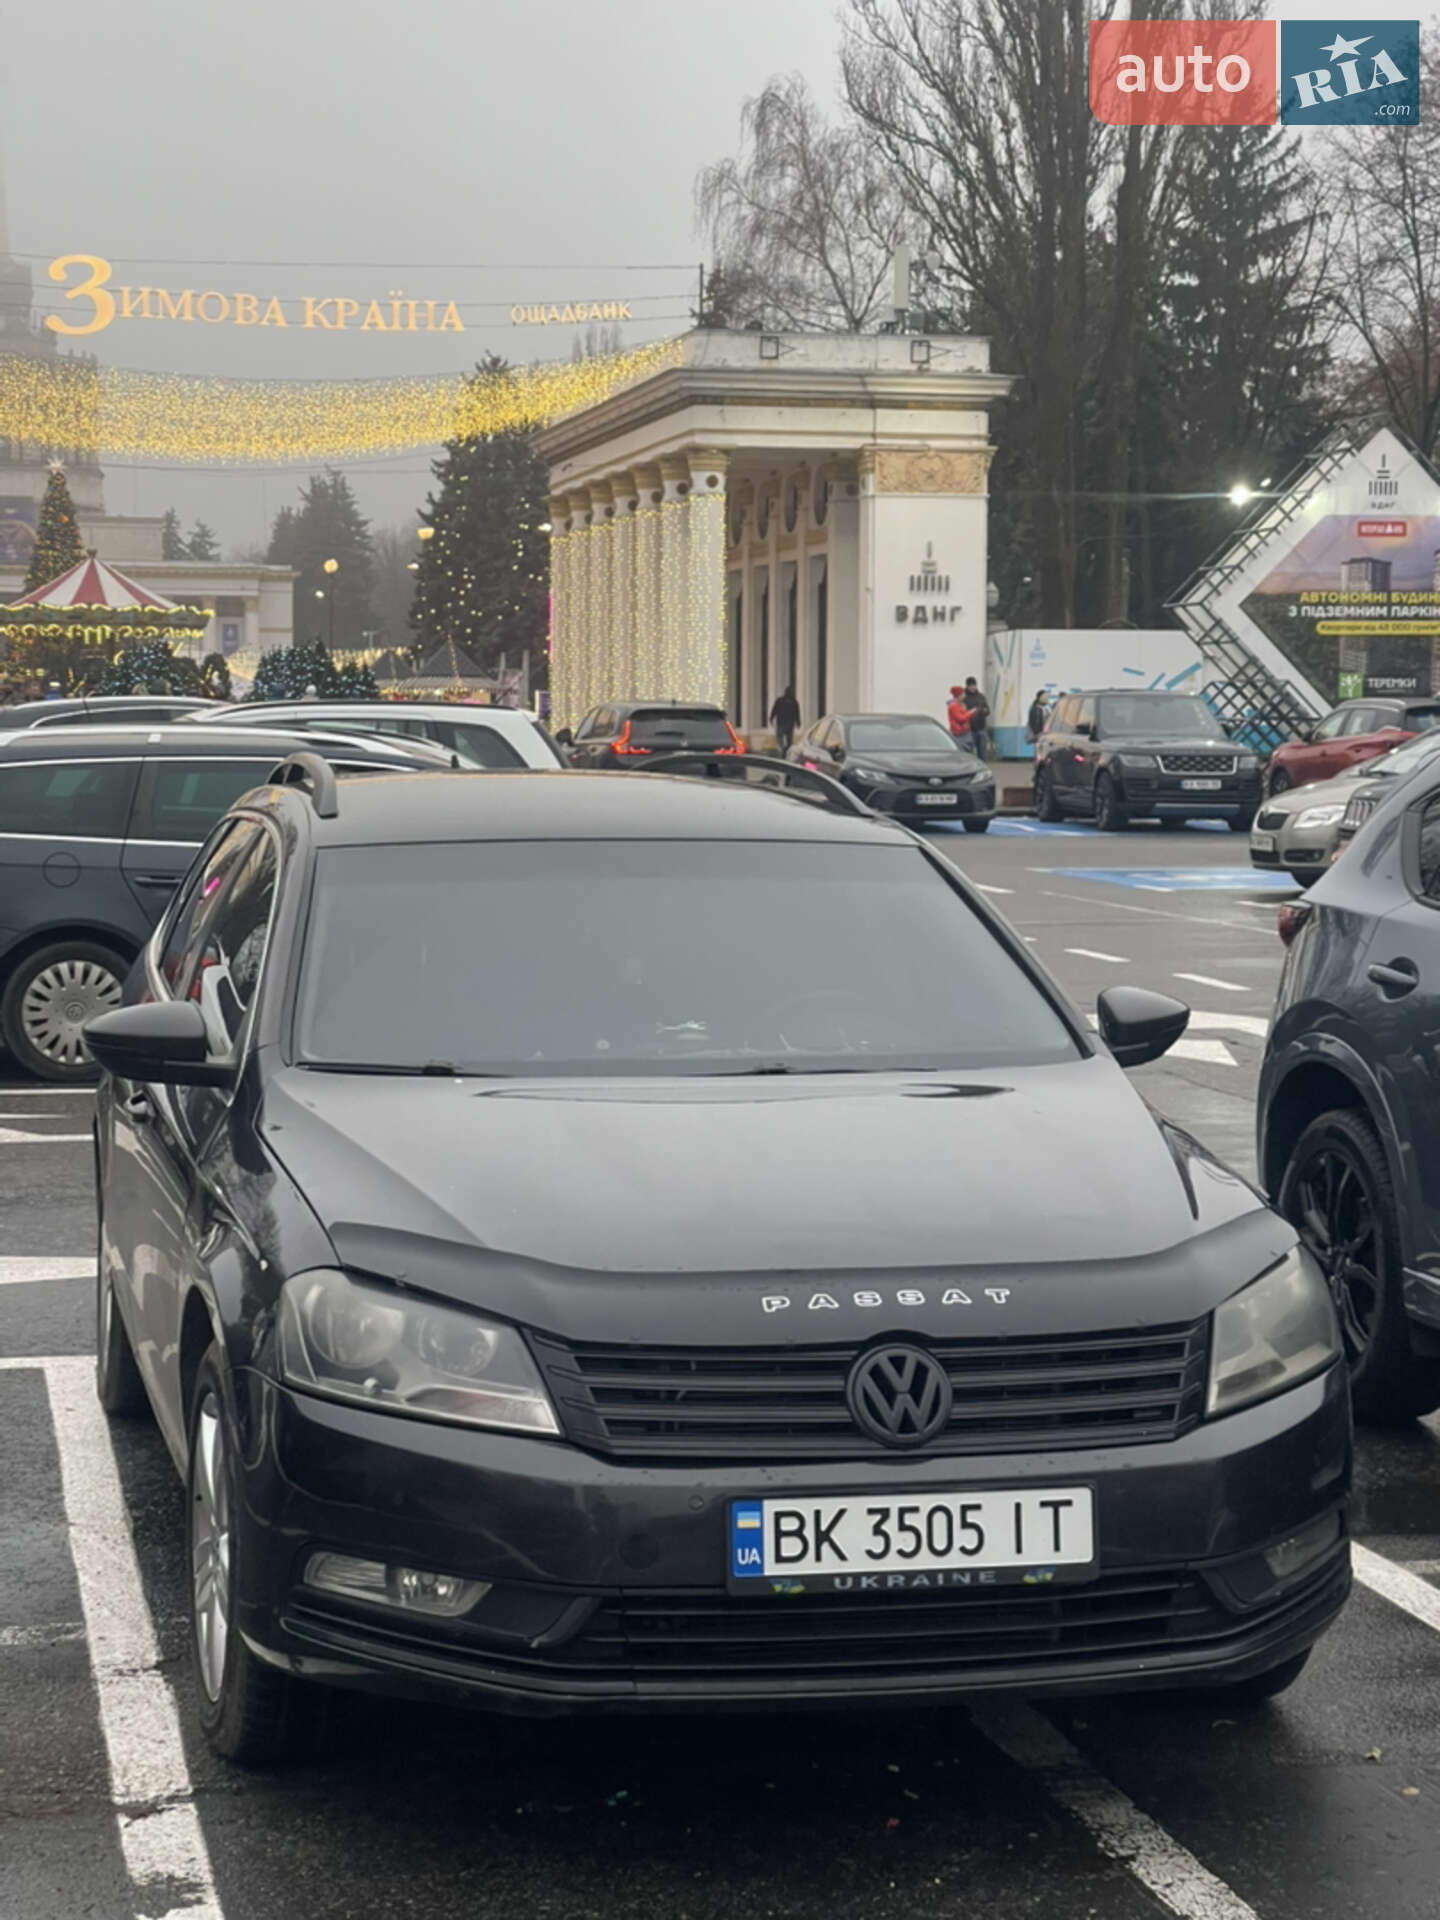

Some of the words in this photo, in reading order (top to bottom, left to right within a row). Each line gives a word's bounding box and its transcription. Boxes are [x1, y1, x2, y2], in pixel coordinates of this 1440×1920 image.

[45, 254, 287, 335] ЗИМОВА
[302, 290, 464, 332] КРАЇНА
[511, 302, 633, 326] ОЩАДБАНК
[1300, 591, 1388, 604] АВТОНОМНІ
[1390, 591, 1440, 605] БУДИН
[895, 604, 963, 625] ВДНГ
[1301, 605, 1388, 618] ПІДЗЕМНИМ
[761, 1287, 1011, 1314] PASSAT
[773, 1507, 849, 1566] BK
[864, 1503, 985, 1562] 3505
[737, 1547, 762, 1566] UA
[833, 1570, 998, 1591] UKRAINE
